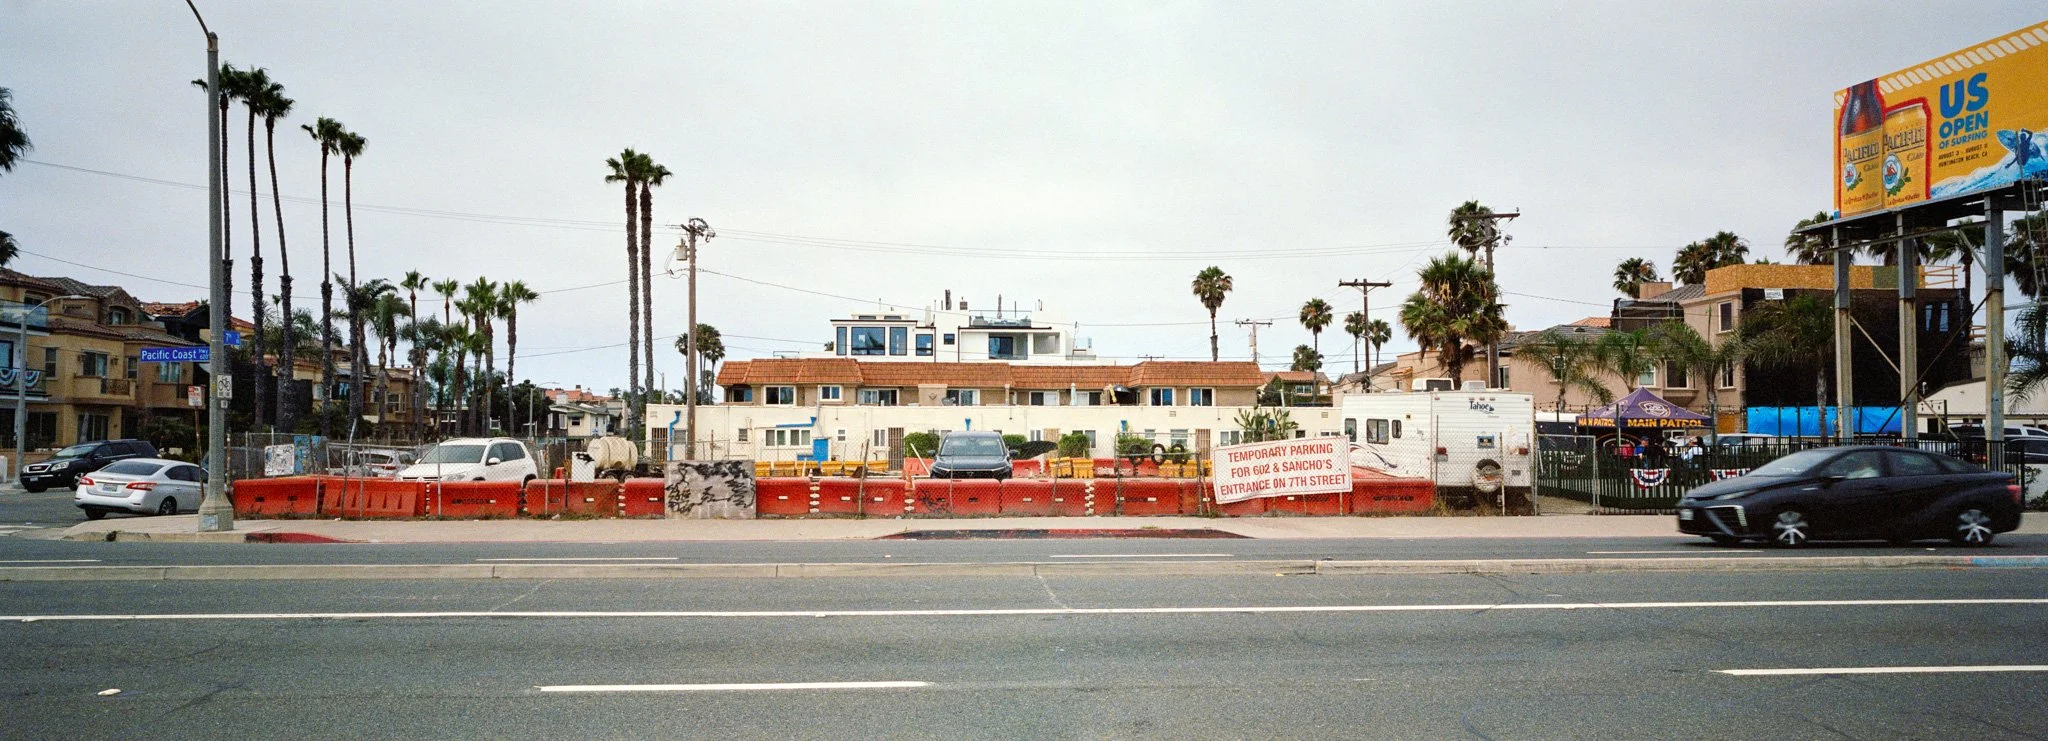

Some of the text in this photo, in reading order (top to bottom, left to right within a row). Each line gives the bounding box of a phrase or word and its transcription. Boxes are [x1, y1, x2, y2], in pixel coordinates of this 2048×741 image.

[1940, 72, 1989, 119] US
[1939, 111, 1988, 139] OPEN
[1939, 131, 1987, 150] OF SURFING
[1938, 151, 1954, 160] AUGUST
[1965, 144, 1982, 153] AUGUST
[1938, 157, 1964, 168] HUNTINGTON
[141, 349, 197, 360] Pacific Coast
[1468, 400, 1489, 410] Tahoe
[1593, 417, 1616, 427] PATROL
[1627, 419, 1703, 427] MAIN PATROL
[1228, 443, 1334, 463] TEMPORARY PARKING
[1231, 459, 1333, 479] FOR 602 & SANCHO'S
[1220, 474, 1347, 496] ENTRANCE ON 7TH STREET
